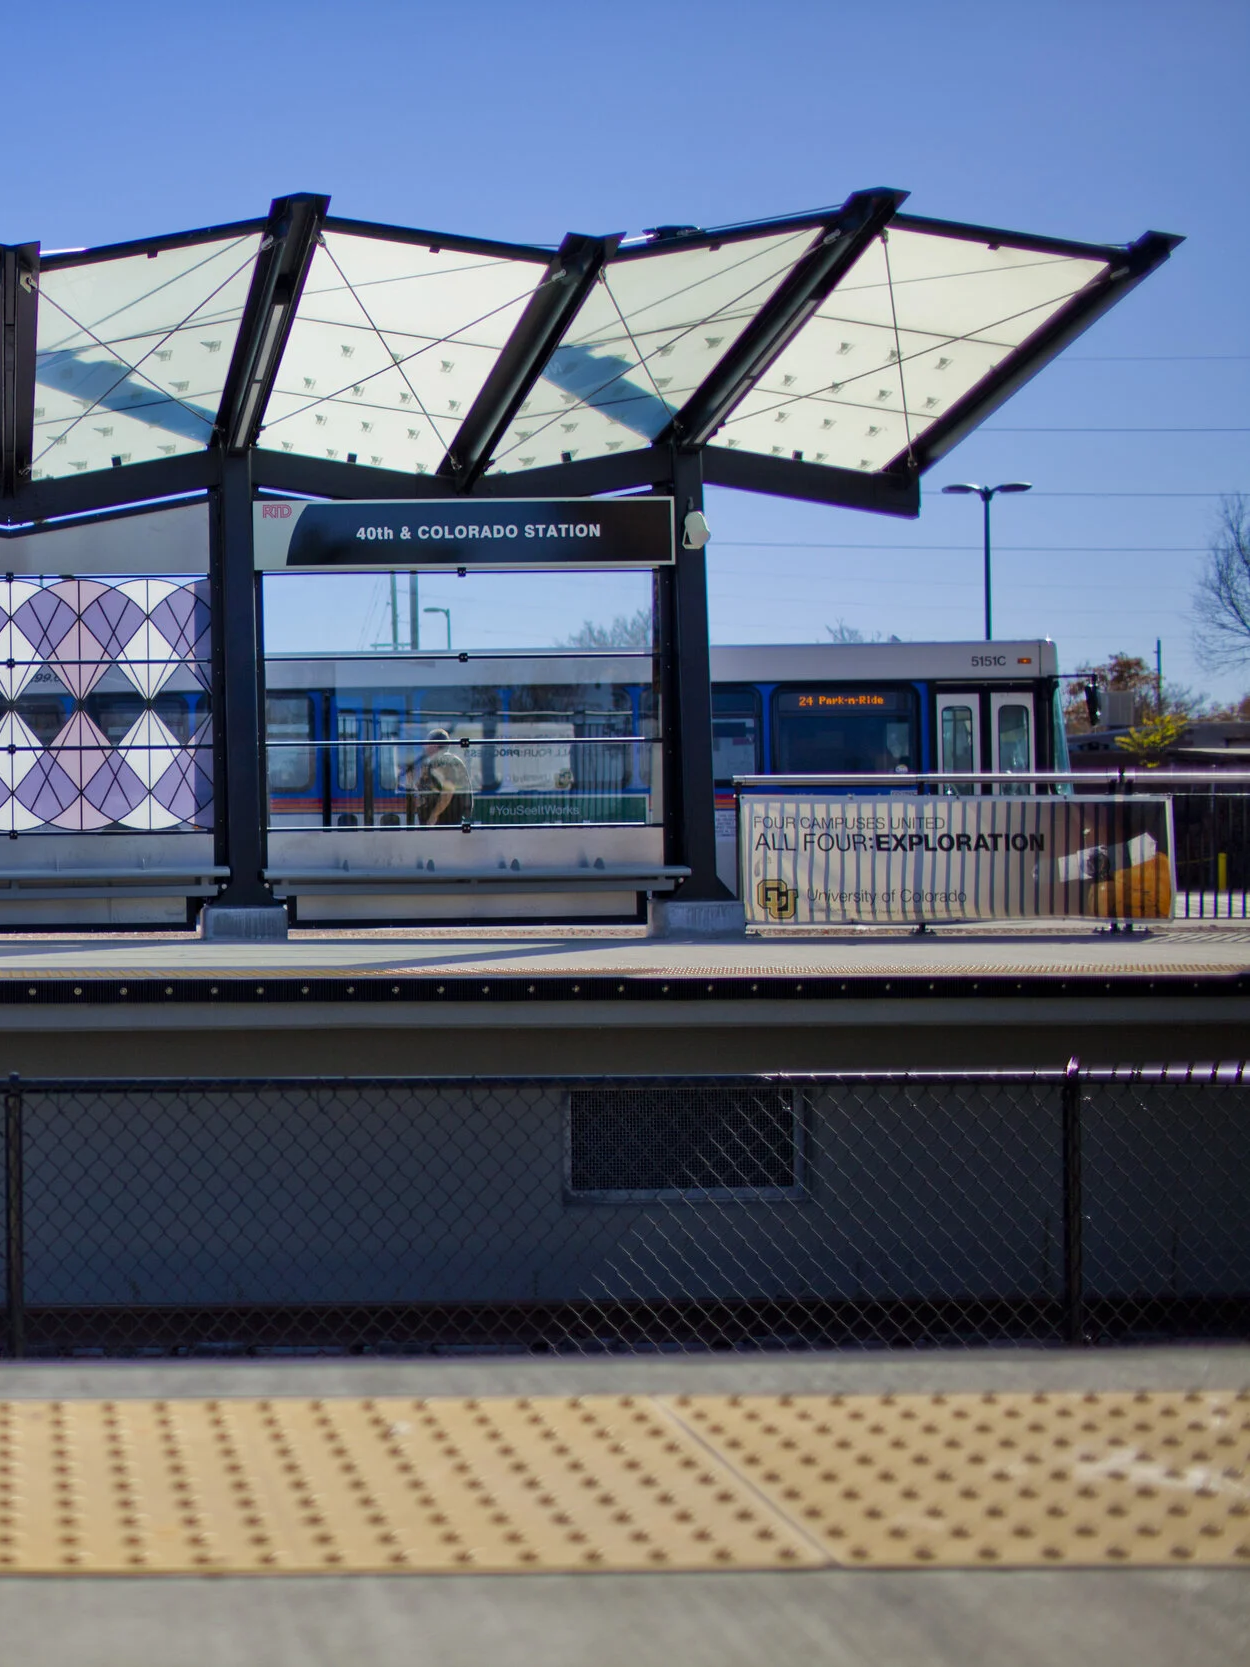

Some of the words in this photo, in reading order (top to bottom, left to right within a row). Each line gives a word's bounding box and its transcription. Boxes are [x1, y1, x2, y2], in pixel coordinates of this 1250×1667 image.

[262, 504, 292, 519] RTD
[356, 526, 394, 540] 40th
[400, 525, 412, 540] &
[417, 525, 518, 540] COLORADO
[524, 523, 601, 538] STATION
[971, 655, 1007, 667] 5151C
[798, 695, 814, 707] 24
[818, 695, 885, 705] Park-n-Ride
[490, 805, 580, 816] #YouSeeItWorks
[754, 816, 795, 830] FOUR
[800, 816, 886, 830] CAMPUSES
[890, 817, 945, 830] UNITED
[755, 833, 796, 851] ALL
[803, 833, 1045, 852] FOUR:EXPLORATION
[807, 888, 878, 906] University
[881, 889, 896, 902] of
[900, 888, 967, 903] Colorado
